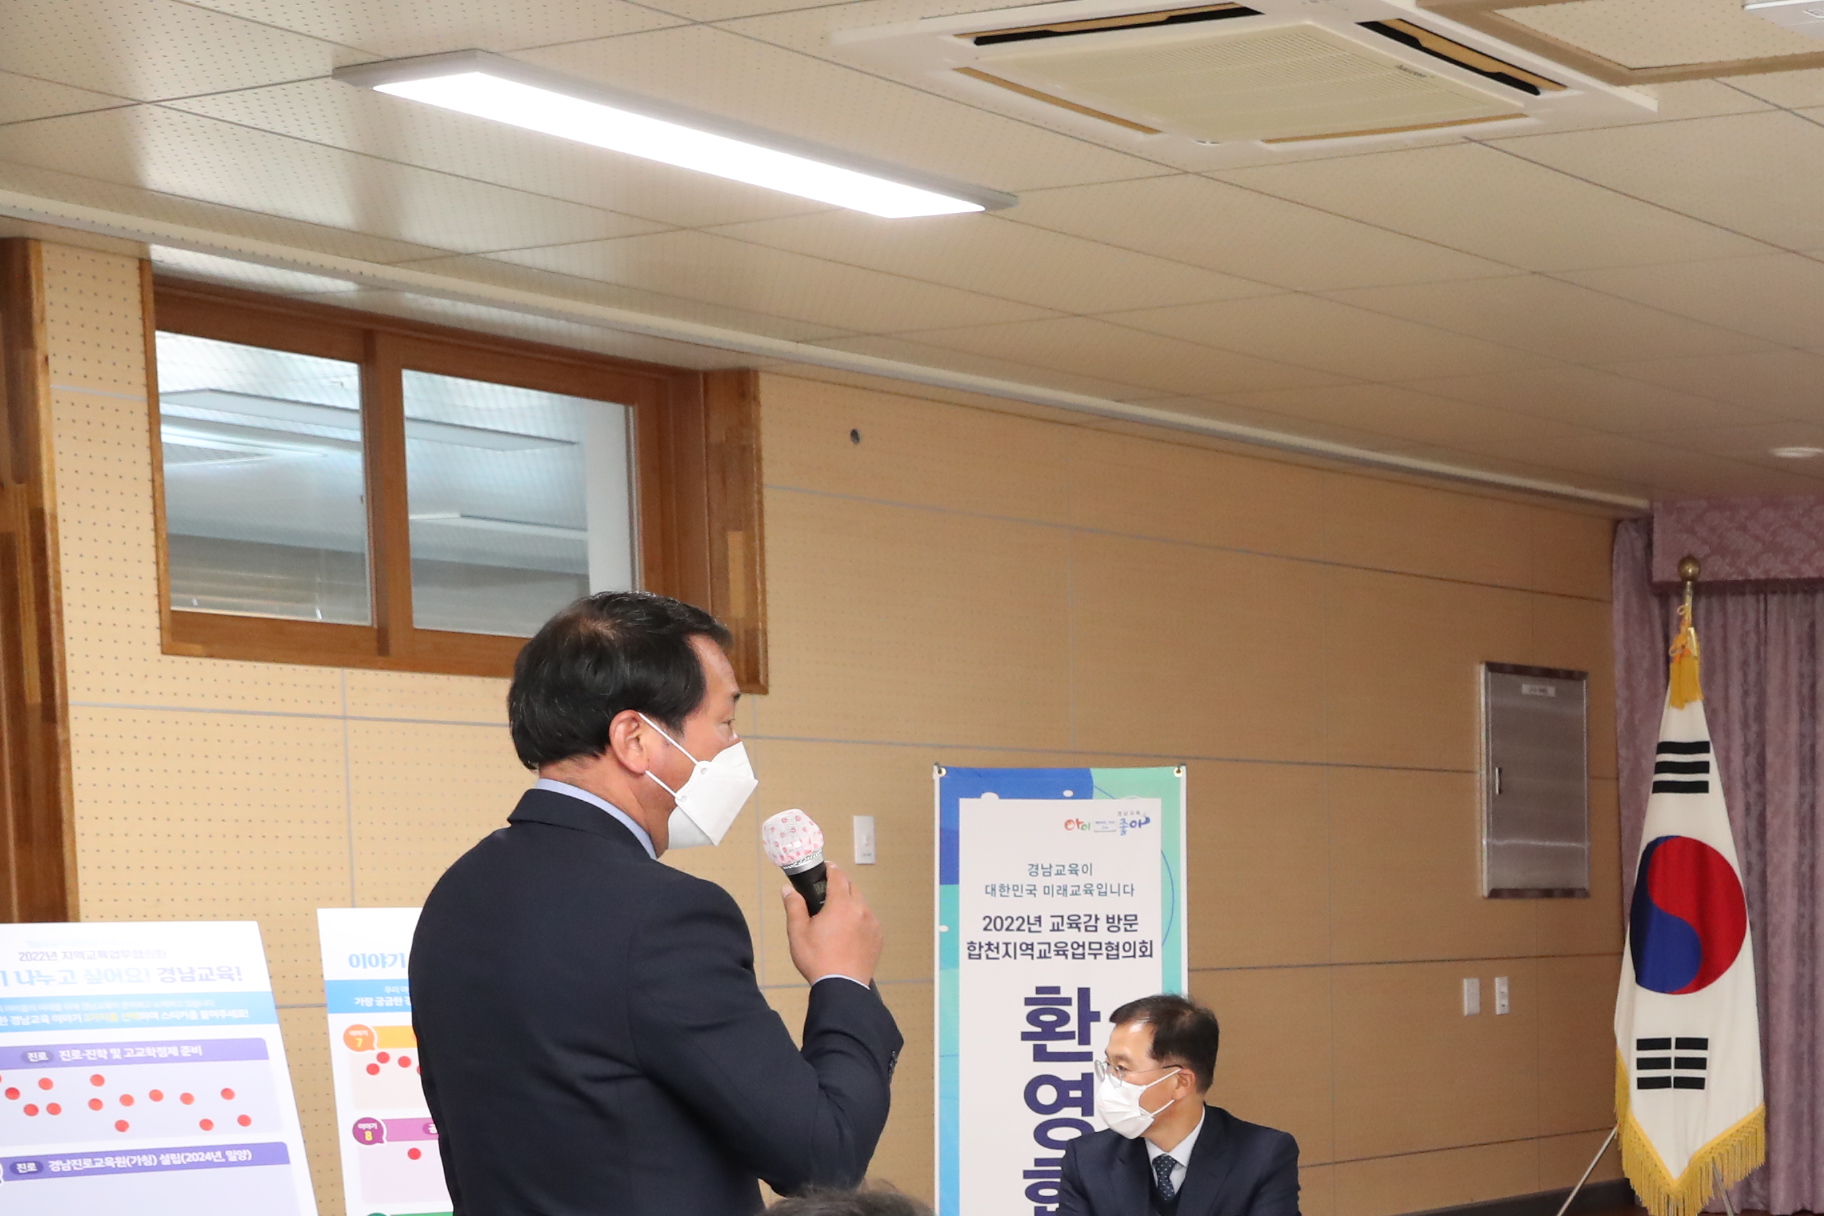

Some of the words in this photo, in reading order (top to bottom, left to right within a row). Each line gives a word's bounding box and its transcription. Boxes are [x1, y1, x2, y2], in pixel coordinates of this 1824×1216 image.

[1027, 862, 1093, 878] 경남교육이
[985, 882, 1038, 899] 대한민국
[1043, 881, 1135, 898] 미래교육입니다
[982, 914, 1043, 934] 2022년
[1049, 913, 1100, 935] 교육감
[1106, 913, 1139, 933] 방문
[966, 938, 1154, 962] 합천지역교육업무협의회
[348, 952, 406, 969] 이야기
[14, 969, 78, 986] 나누고
[156, 965, 243, 984] 경남교육!
[354, 997, 374, 1007] 가장
[356, 1038, 363, 1048] 7
[27, 1051, 49, 1063] 진로
[364, 1131, 373, 1141] 8
[17, 1161, 38, 1173] 진로
